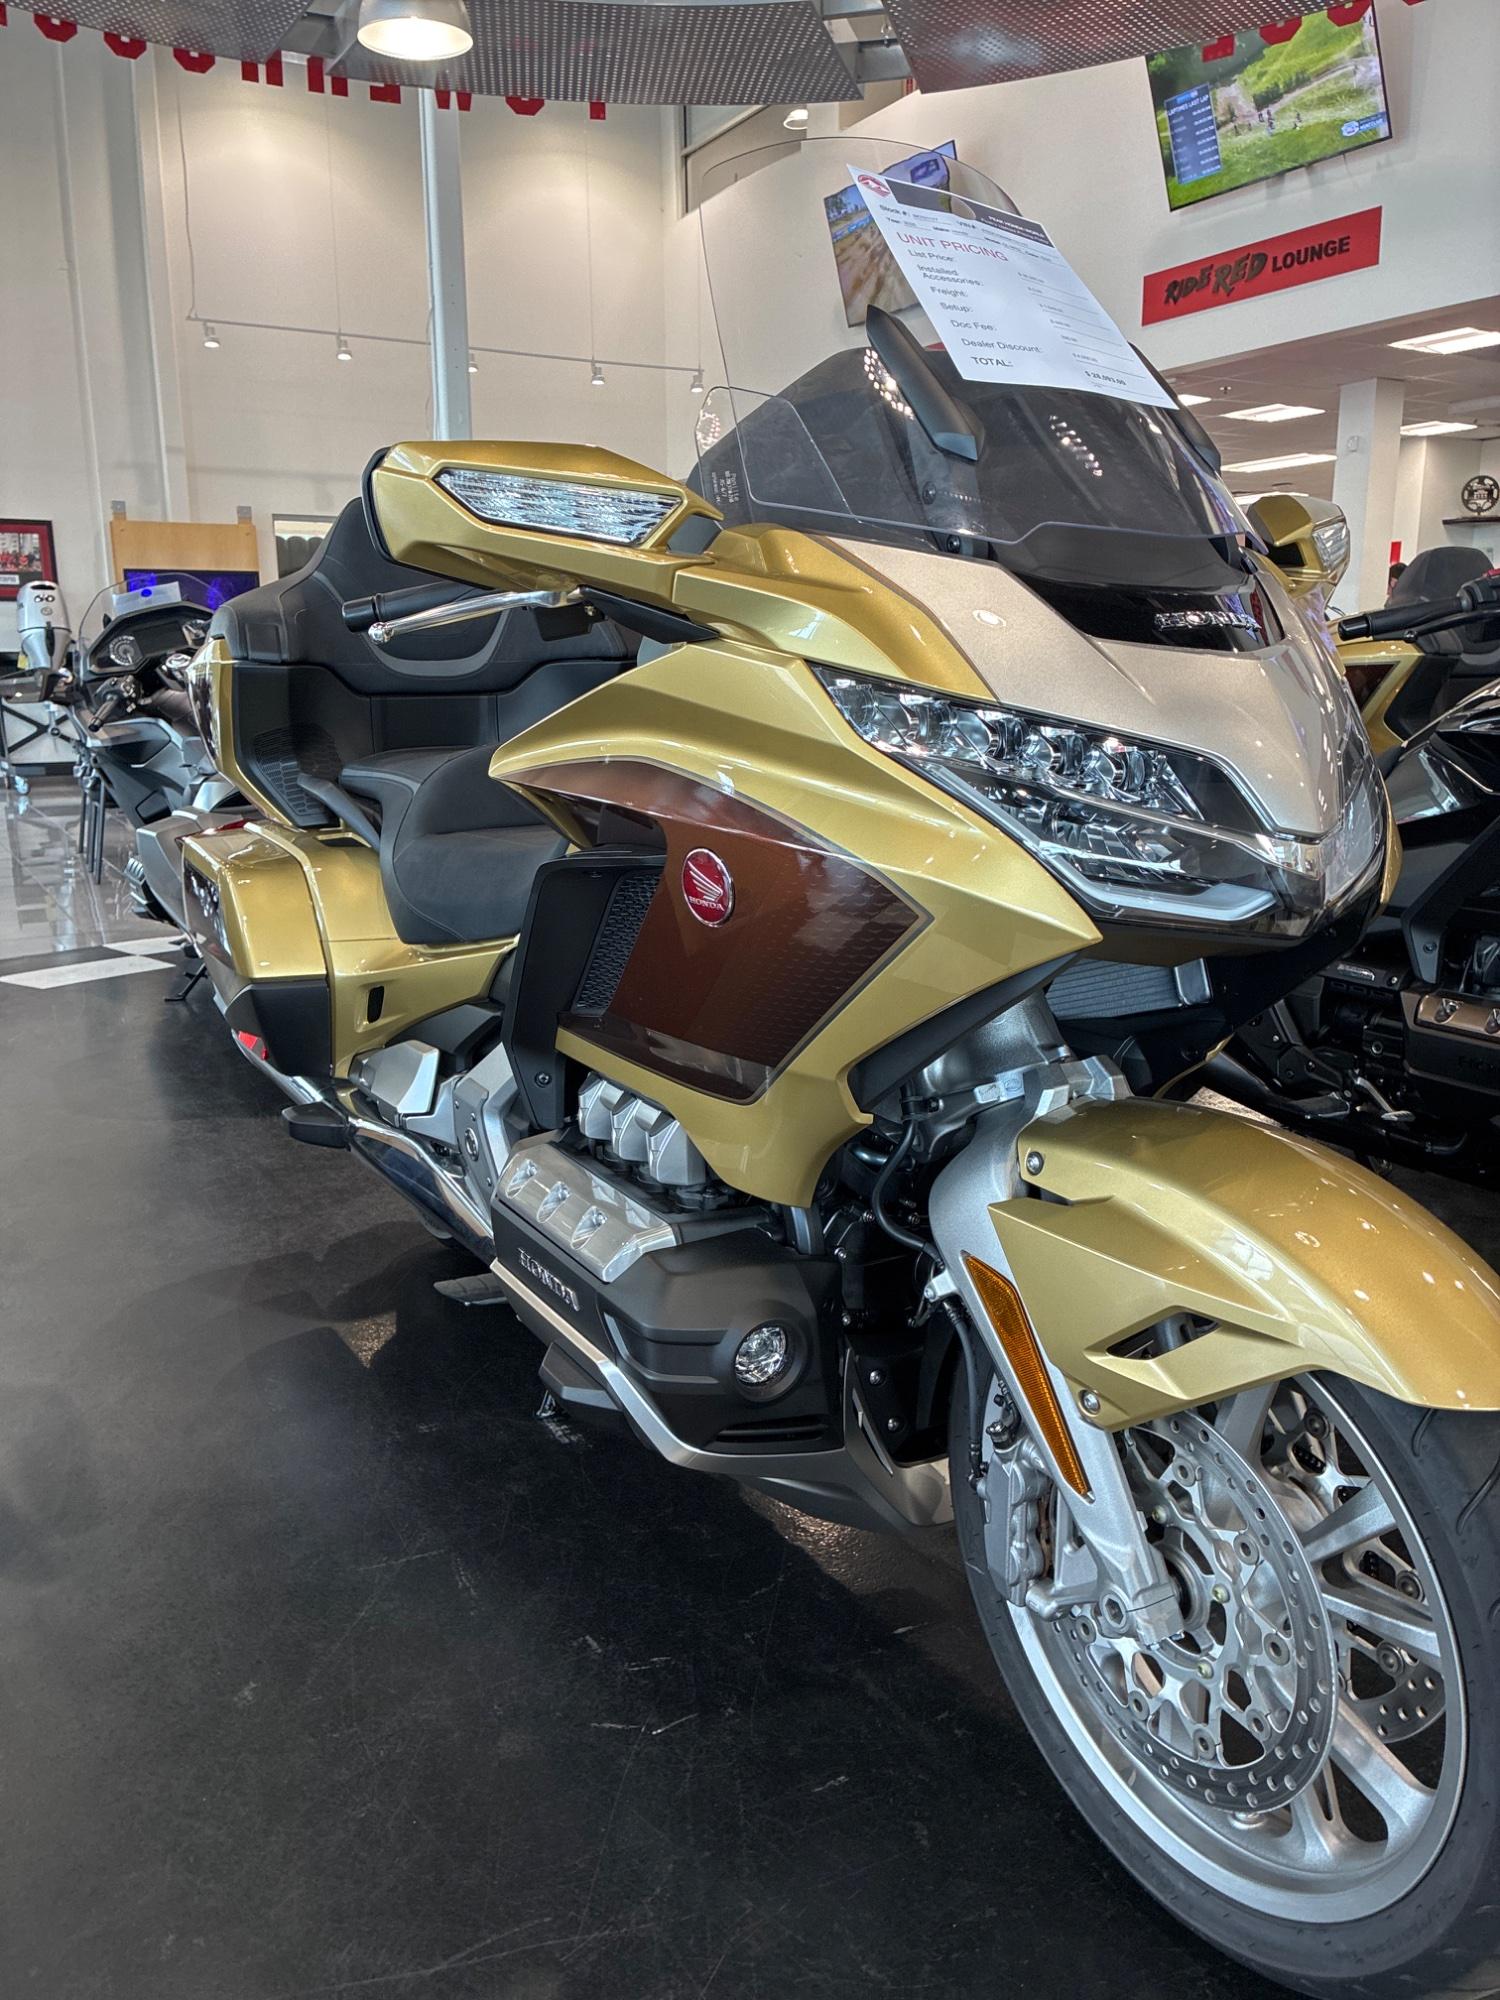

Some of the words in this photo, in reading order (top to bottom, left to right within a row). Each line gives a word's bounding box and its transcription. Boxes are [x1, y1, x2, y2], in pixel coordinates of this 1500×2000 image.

[897, 231, 936, 249] UNIT
[940, 239, 1009, 262] PRICING
[908, 249, 927, 259] List
[928, 251, 957, 263] Price:
[1164, 264, 1214, 305] RIDE
[1211, 252, 1268, 297] RED
[1271, 236, 1351, 273] LOUNGE
[923, 272, 984, 287] Accessories:
[929, 286, 968, 298] Freight:
[939, 302, 974, 313] Setup:
[950, 319, 972, 329] Doc
[973, 321, 998, 332] Fee:
[961, 337, 995, 349] Dealer
[997, 340, 1043, 353] Discount:
[971, 356, 1014, 367] TOTAL:
[1154, 610, 1263, 632] HONDA
[688, 895, 725, 912] HONDA
[517, 1247, 581, 1312] HONDA
